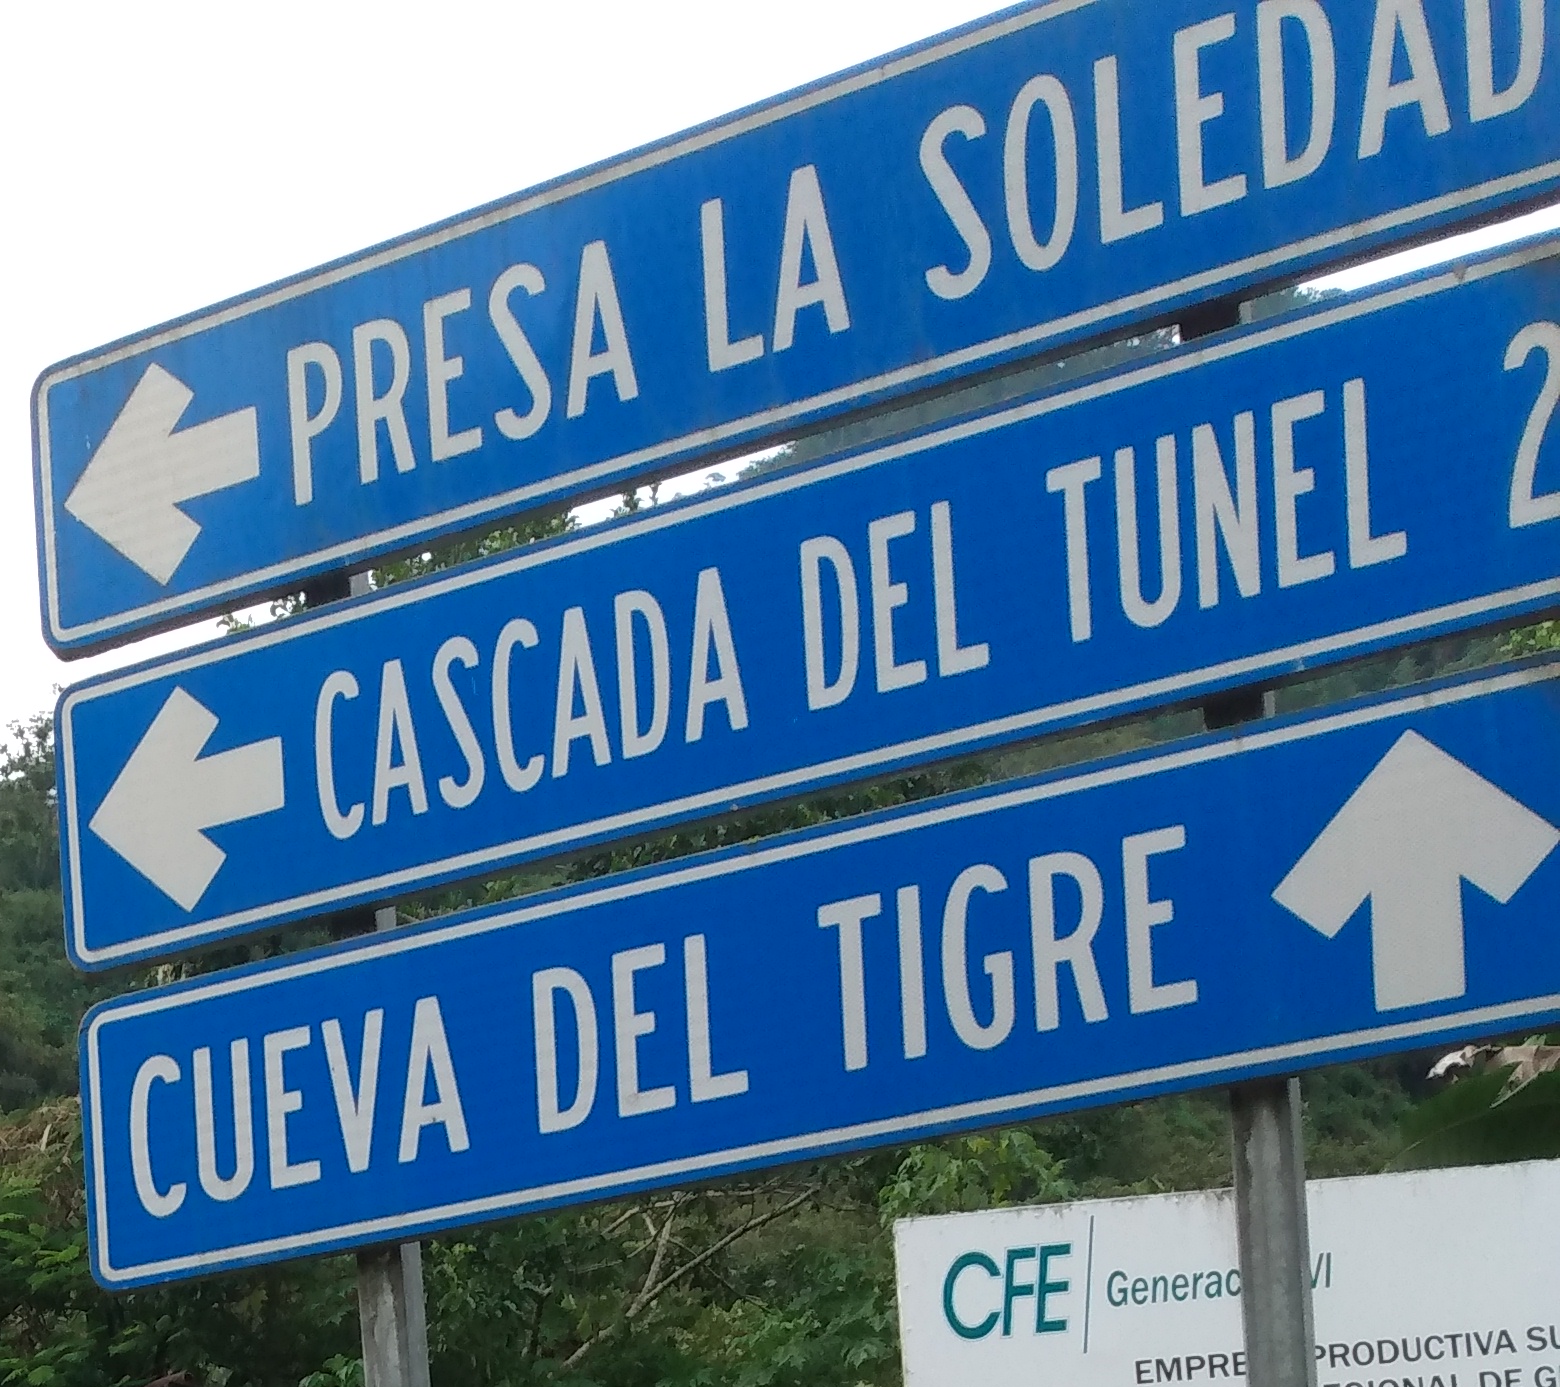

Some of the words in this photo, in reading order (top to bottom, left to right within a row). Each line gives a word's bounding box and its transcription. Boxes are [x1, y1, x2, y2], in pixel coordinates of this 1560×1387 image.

[287, 240, 638, 505] PRESA
[702, 166, 850, 373] LA
[920, 0, 1545, 300] SOLEDAD
[313, 565, 749, 841] CASCADA
[800, 500, 991, 707] DEL
[1046, 378, 1407, 646] TUNEL
[130, 995, 469, 1218] CUEVA
[533, 932, 749, 1134] DEL
[818, 823, 1198, 1071] TIGRE
[942, 1242, 1071, 1341] CFE
[1107, 1268, 1242, 1308] Generac
[1136, 1351, 1247, 1385] EMPRE
